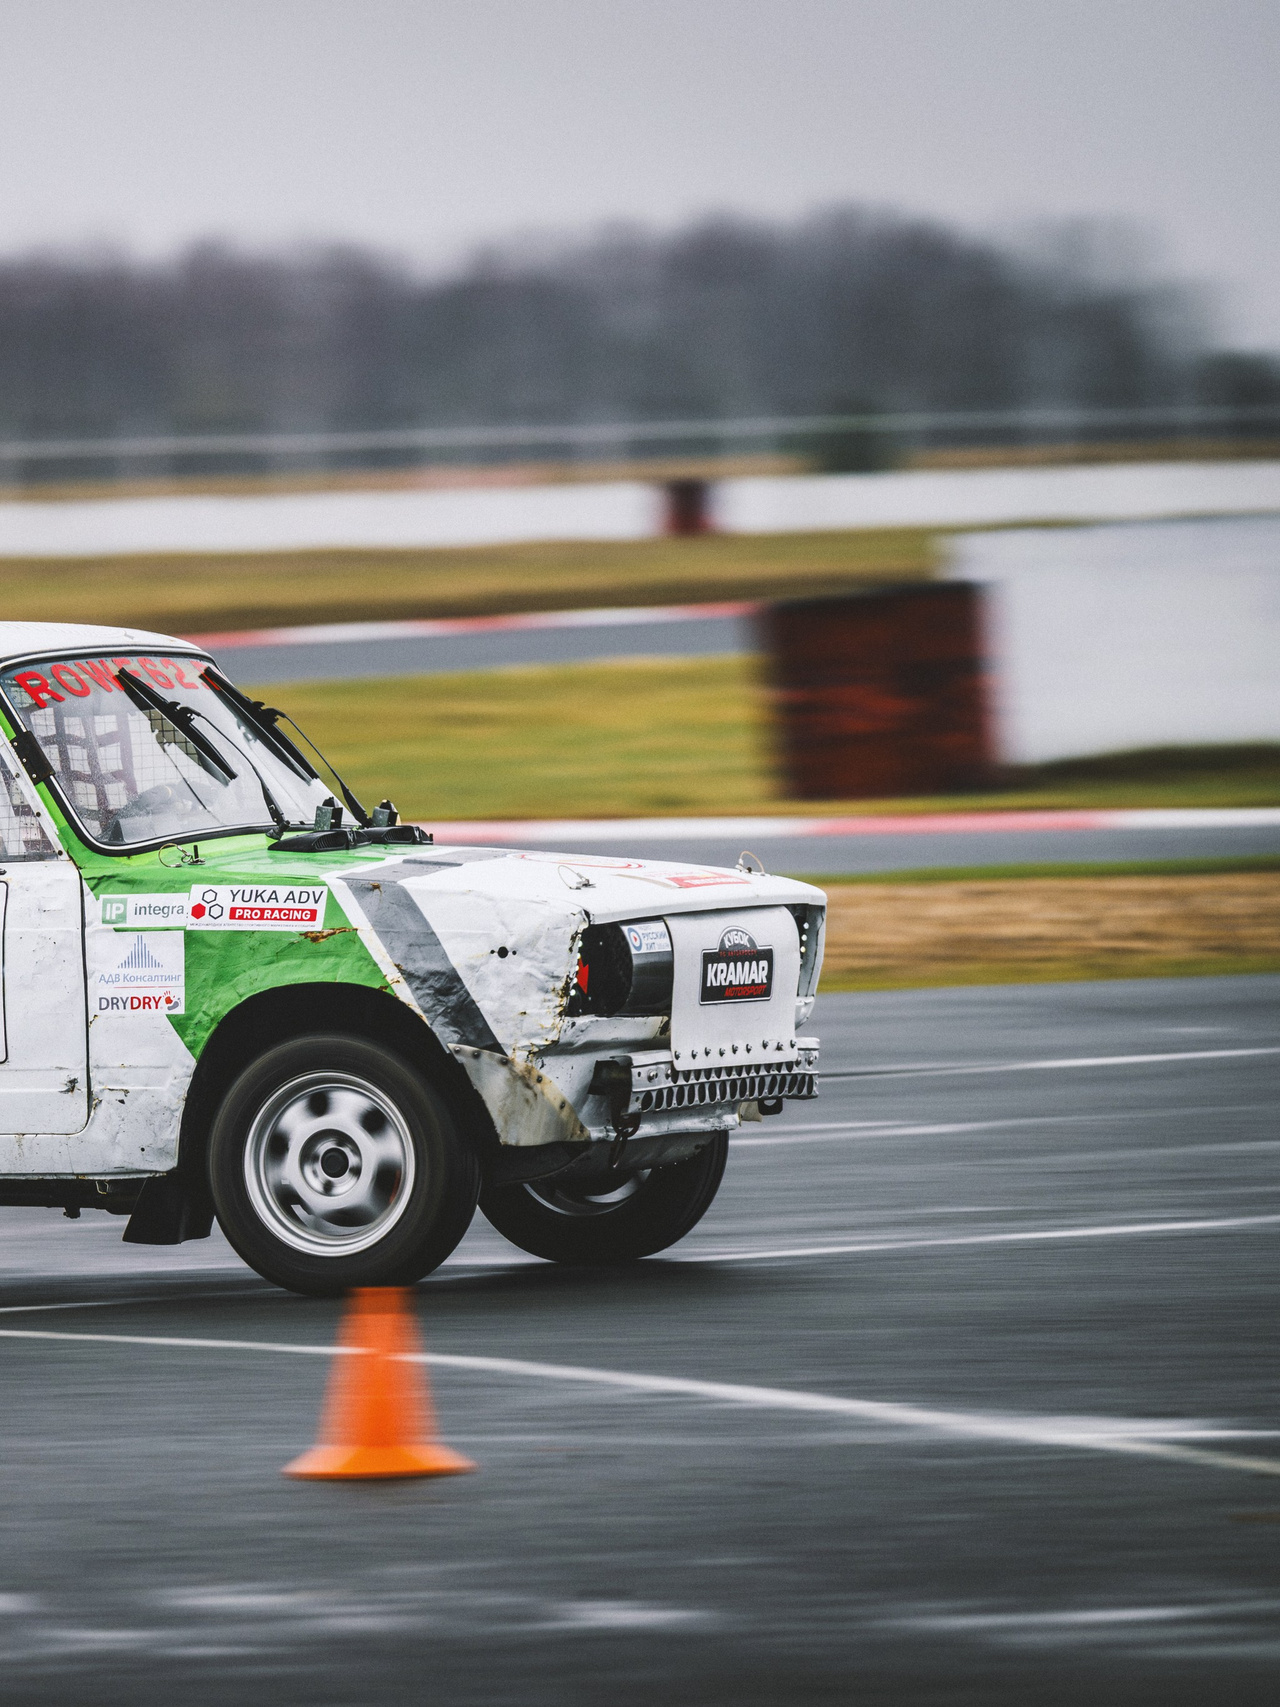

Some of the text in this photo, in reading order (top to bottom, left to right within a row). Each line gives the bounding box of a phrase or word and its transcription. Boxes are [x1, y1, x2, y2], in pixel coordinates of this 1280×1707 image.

[230, 889, 324, 904] YUKA ADV
[105, 902, 185, 920] IP integra
[235, 908, 311, 920] PRO RACING
[723, 931, 751, 949] КУБОК
[98, 973, 182, 985] АДВ Консалтинг
[706, 960, 768, 987] KRAMAR
[723, 985, 767, 998] MOTORSPORT
[99, 995, 162, 1011] DRYDRY
